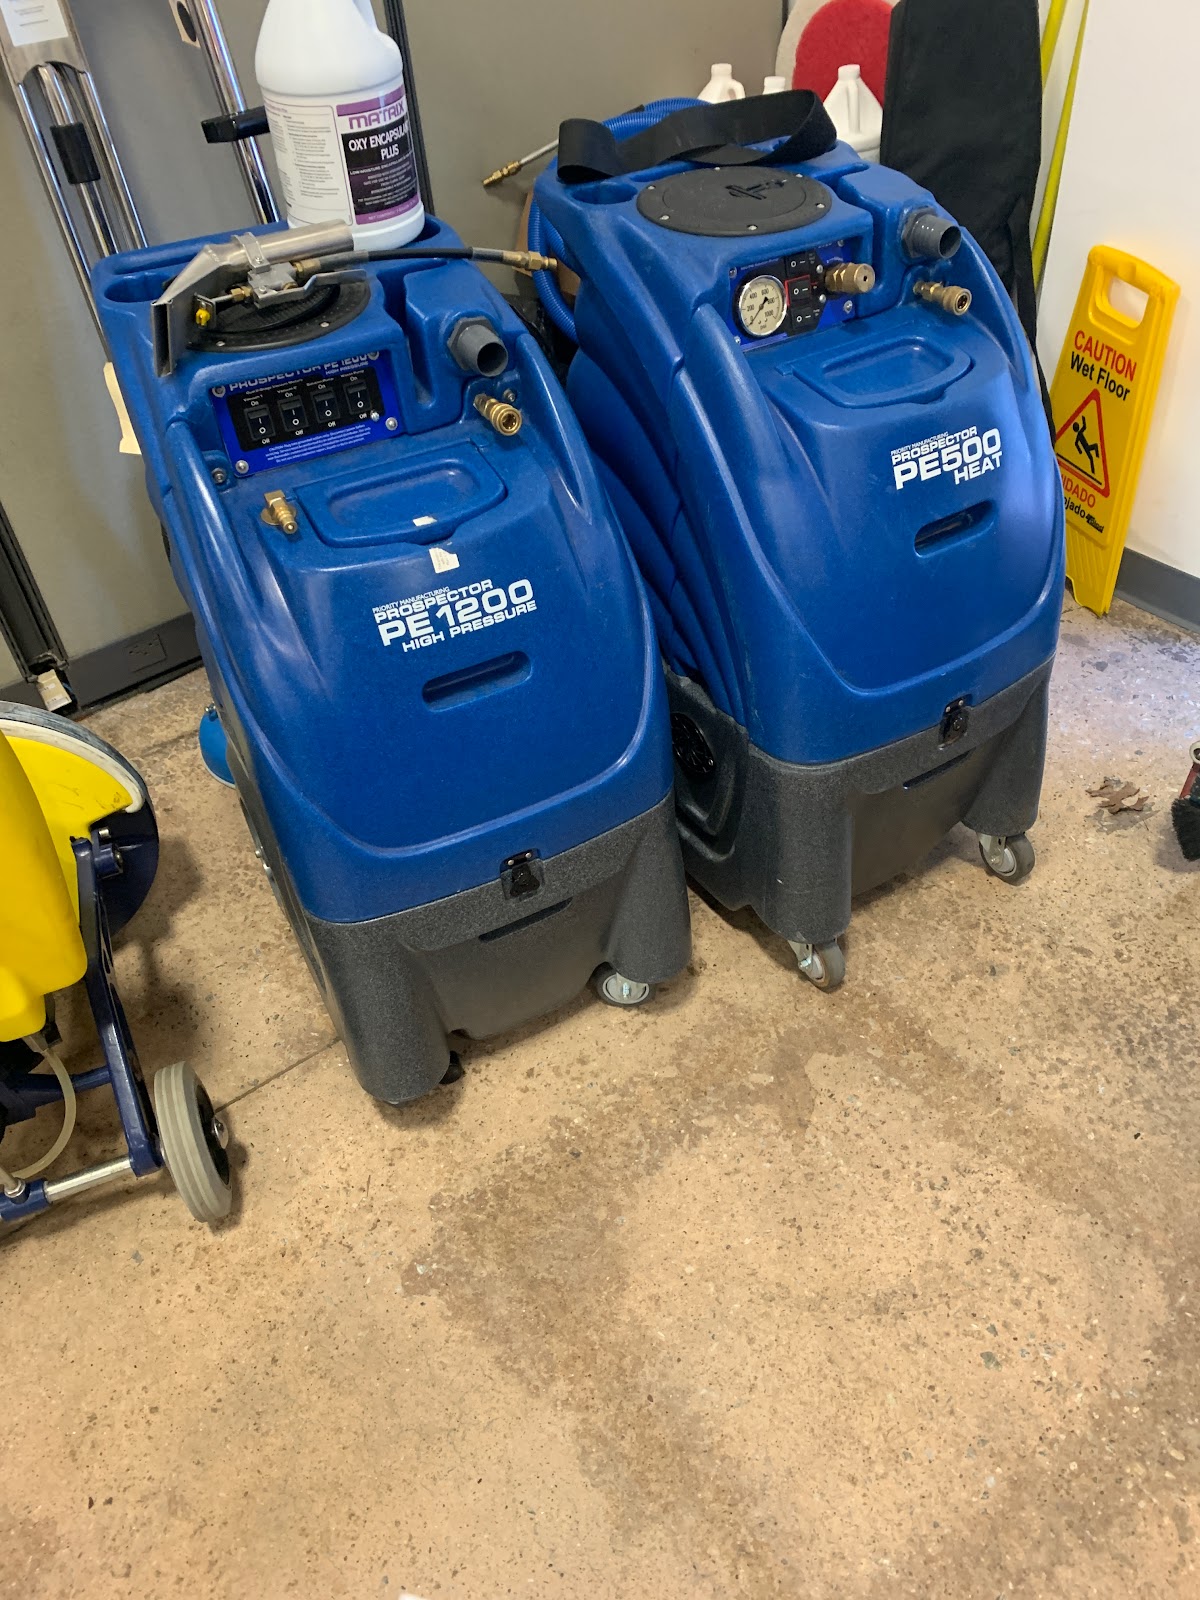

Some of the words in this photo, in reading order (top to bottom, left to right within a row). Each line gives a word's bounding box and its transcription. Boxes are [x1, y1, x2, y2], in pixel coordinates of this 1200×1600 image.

[348, 101, 405, 129] MATRIX
[348, 137, 368, 151] OXY
[381, 144, 400, 160] PLUS
[1074, 330, 1137, 382] CAUTION
[1070, 351, 1095, 381] Wet
[1096, 366, 1131, 401] Floor
[891, 425, 978, 465] PROSPECTOR
[893, 427, 1002, 490] PE500
[954, 451, 1003, 485] HEAT
[1061, 474, 1096, 508] IDADO
[1064, 497, 1086, 518] ojado
[372, 601, 399, 614] PRIORITY
[400, 586, 450, 605] MANUFACTURING
[374, 579, 494, 623] PROSPECTOR
[378, 612, 434, 647] PE
[435, 578, 534, 627] 1200
[402, 631, 445, 653] HIGH
[450, 600, 538, 638] PRESSURE
